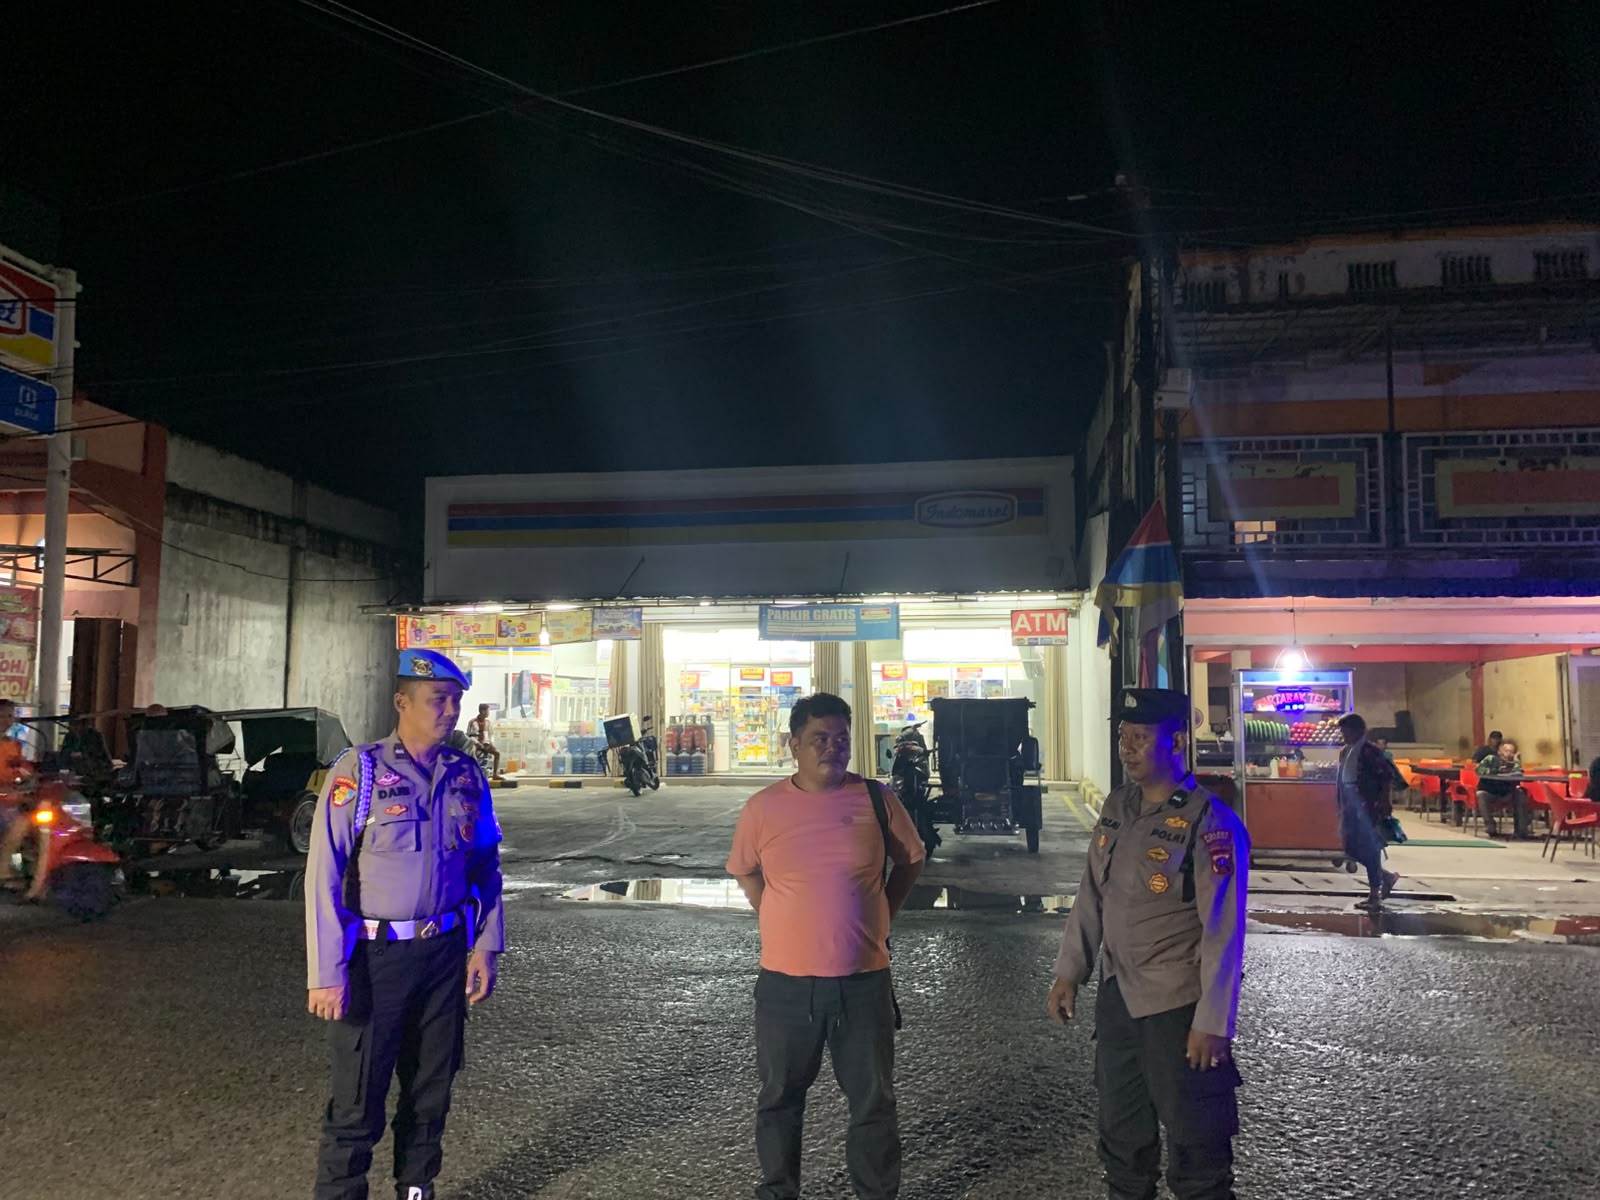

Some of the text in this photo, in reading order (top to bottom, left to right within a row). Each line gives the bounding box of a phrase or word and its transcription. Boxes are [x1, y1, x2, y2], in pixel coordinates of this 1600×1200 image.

[767, 609, 810, 621] PARKIR
[813, 608, 856, 620] GRATIS
[1013, 612, 1066, 632] ATM
[1150, 828, 1187, 845] POLRI
